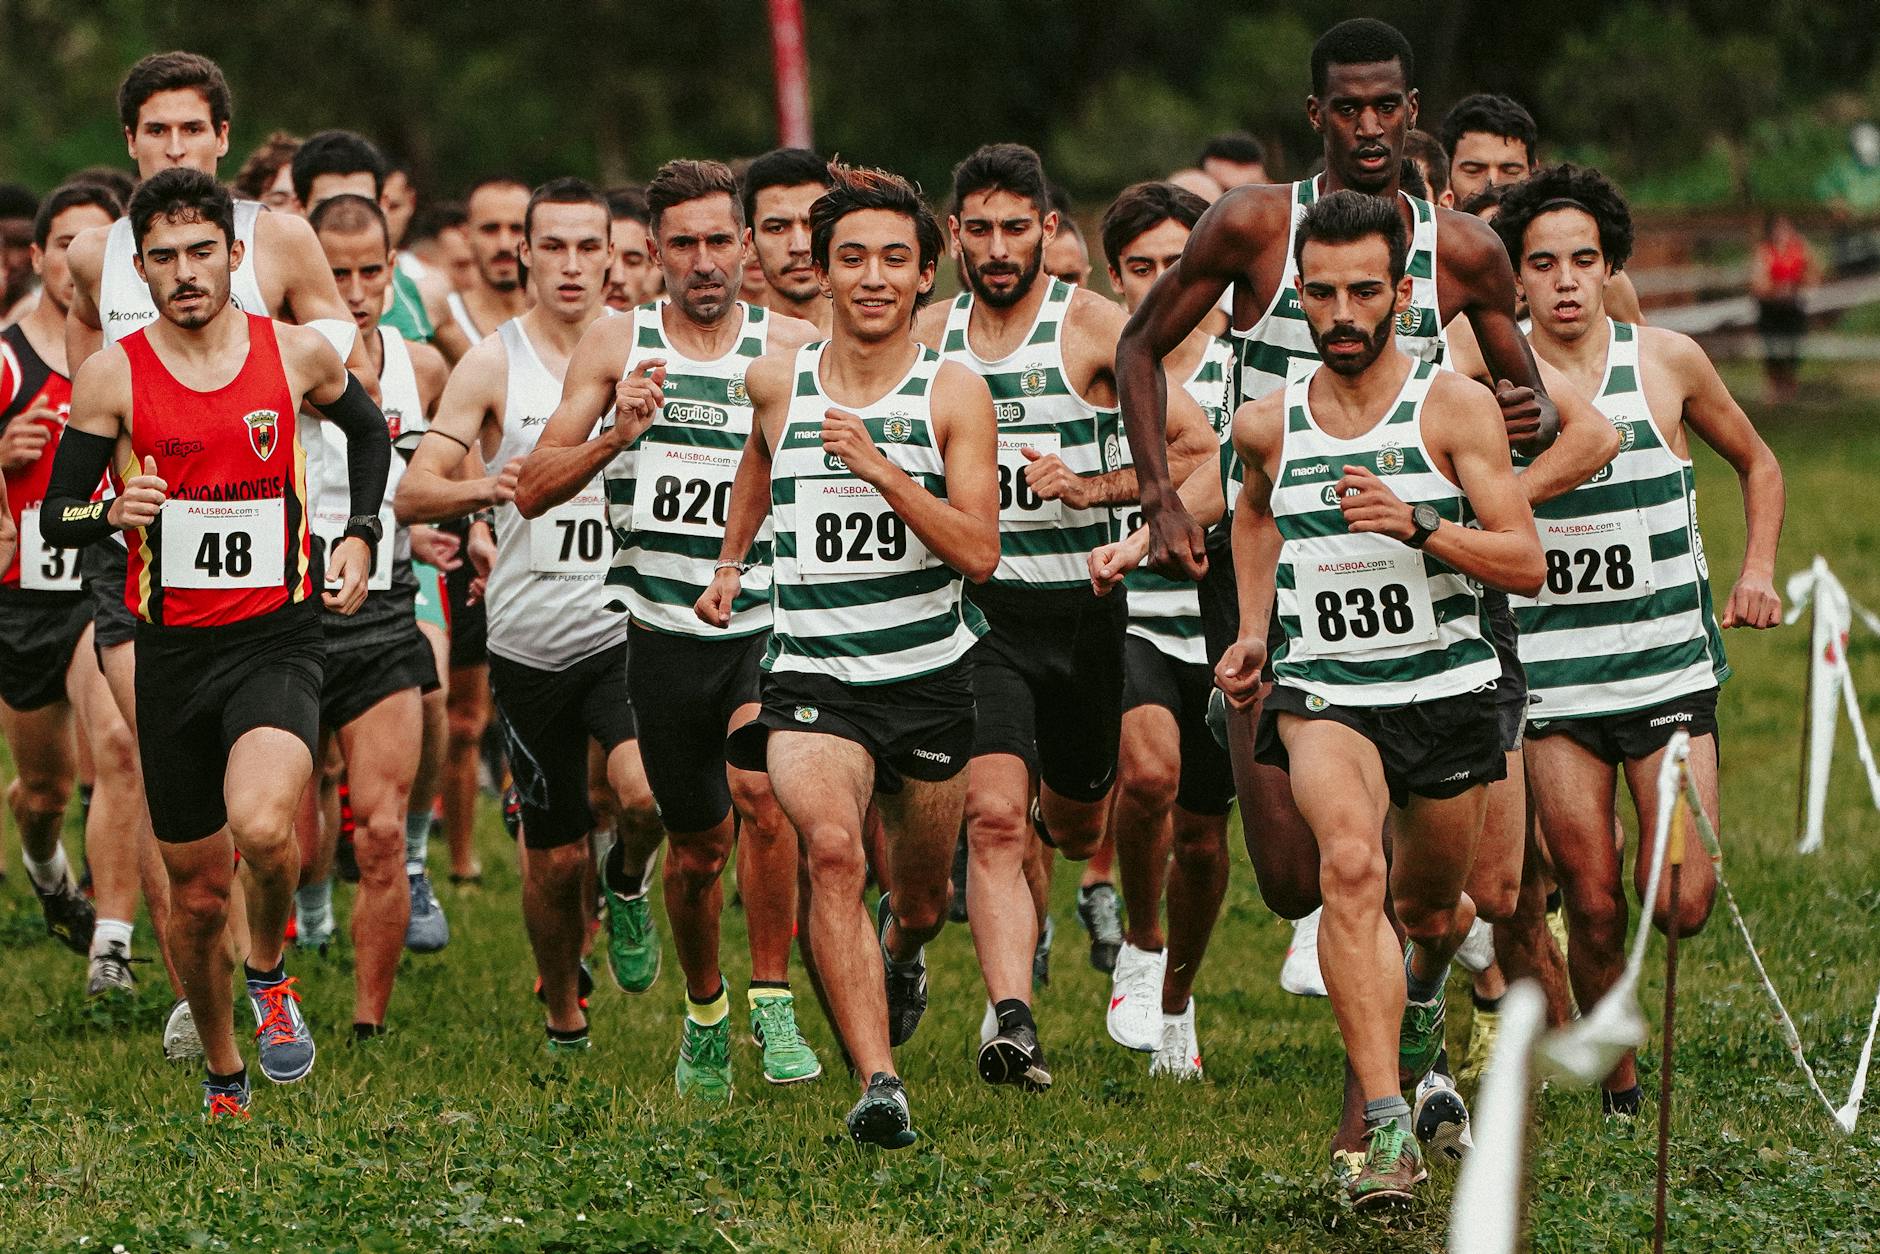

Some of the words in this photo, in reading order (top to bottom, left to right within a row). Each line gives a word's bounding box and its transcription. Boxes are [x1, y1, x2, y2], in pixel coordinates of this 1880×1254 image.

[669, 404, 724, 425] Agriloja
[794, 430, 821, 439] macr
[666, 451, 731, 465] AALISBOA.com
[188, 507, 253, 516] AALISBOA.com
[652, 475, 734, 528] 820
[815, 511, 907, 563] 829
[1548, 521, 1614, 534] AALISBOA.com
[194, 531, 252, 578] 48
[1318, 560, 1387, 573] AALISBOA.com
[1545, 544, 1635, 595] 828
[1315, 583, 1415, 642] 838
